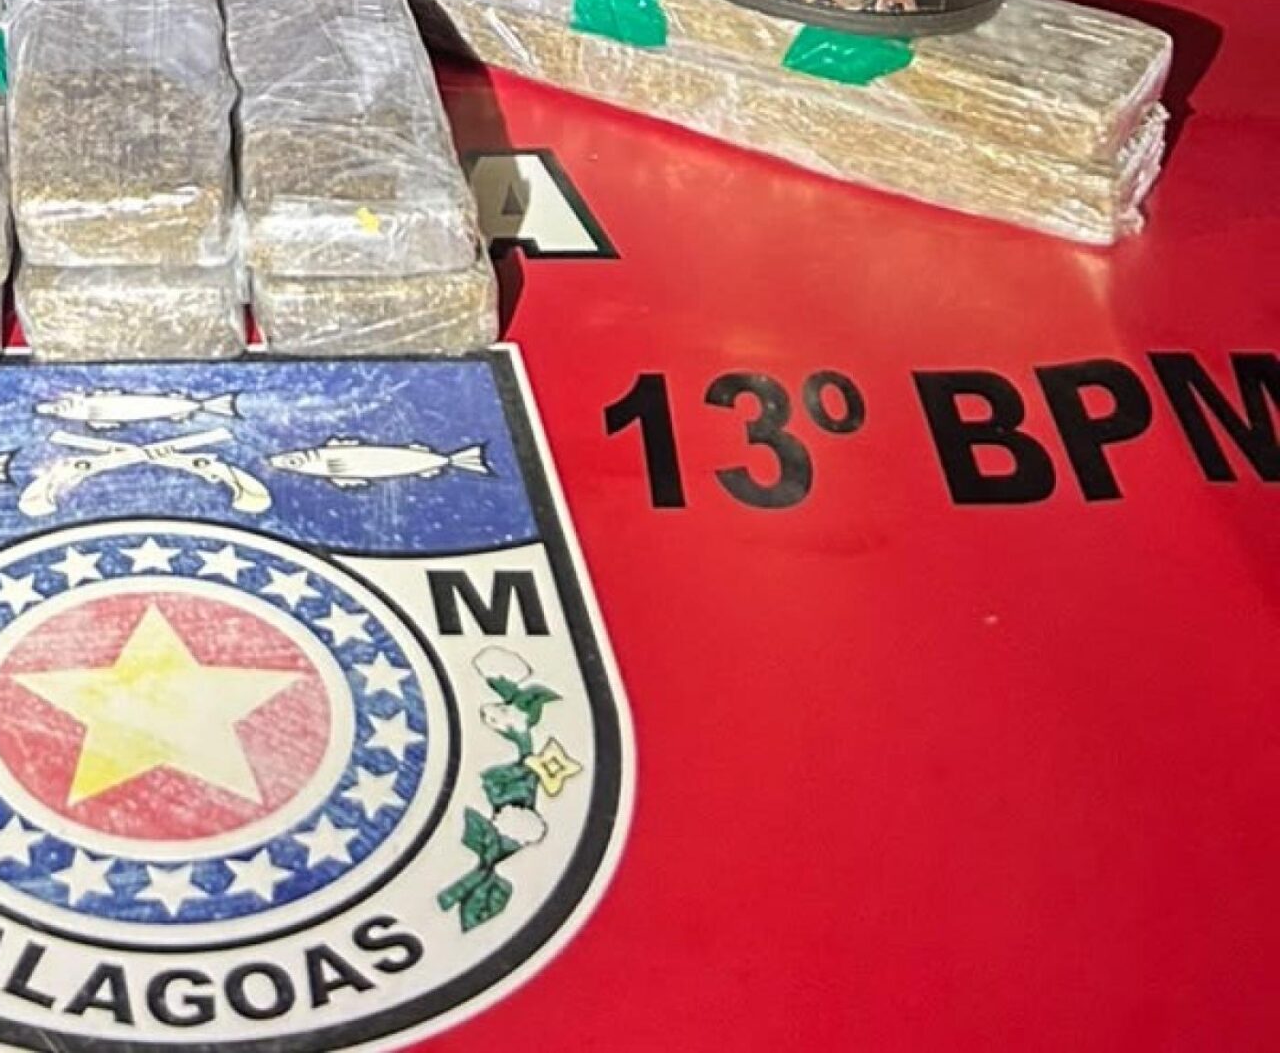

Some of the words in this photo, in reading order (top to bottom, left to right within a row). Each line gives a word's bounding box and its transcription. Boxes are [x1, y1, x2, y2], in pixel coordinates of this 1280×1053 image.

[603, 368, 867, 509] 13º
[913, 350, 1280, 507] BPM
[425, 569, 551, 636] M
